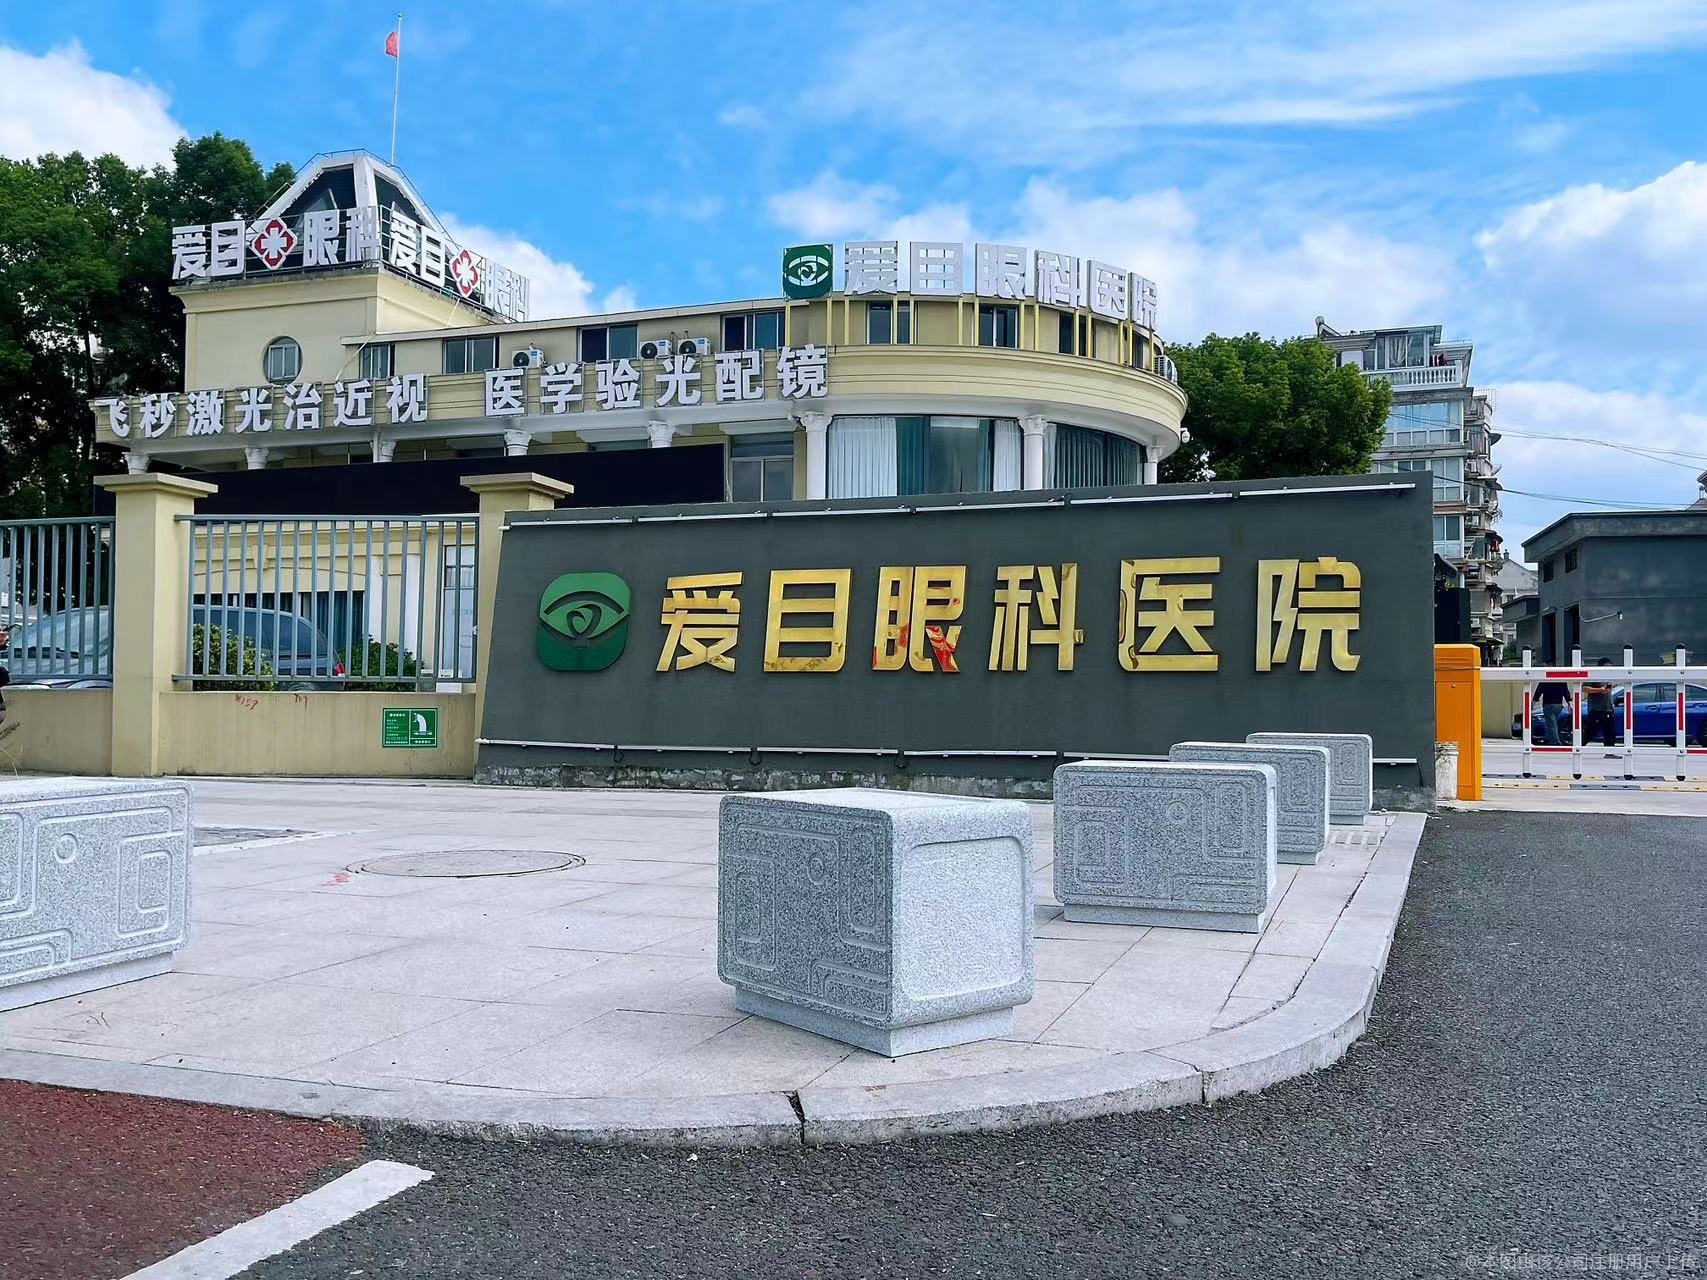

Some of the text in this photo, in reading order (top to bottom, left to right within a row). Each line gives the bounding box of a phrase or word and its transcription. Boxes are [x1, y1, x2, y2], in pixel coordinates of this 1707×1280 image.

[845, 240, 1159, 332] 爱目眼科医院
[95, 344, 828, 438] 飞秒激光治近视 医学验光配镜
[656, 556, 1361, 673] 爱目眼科医院
